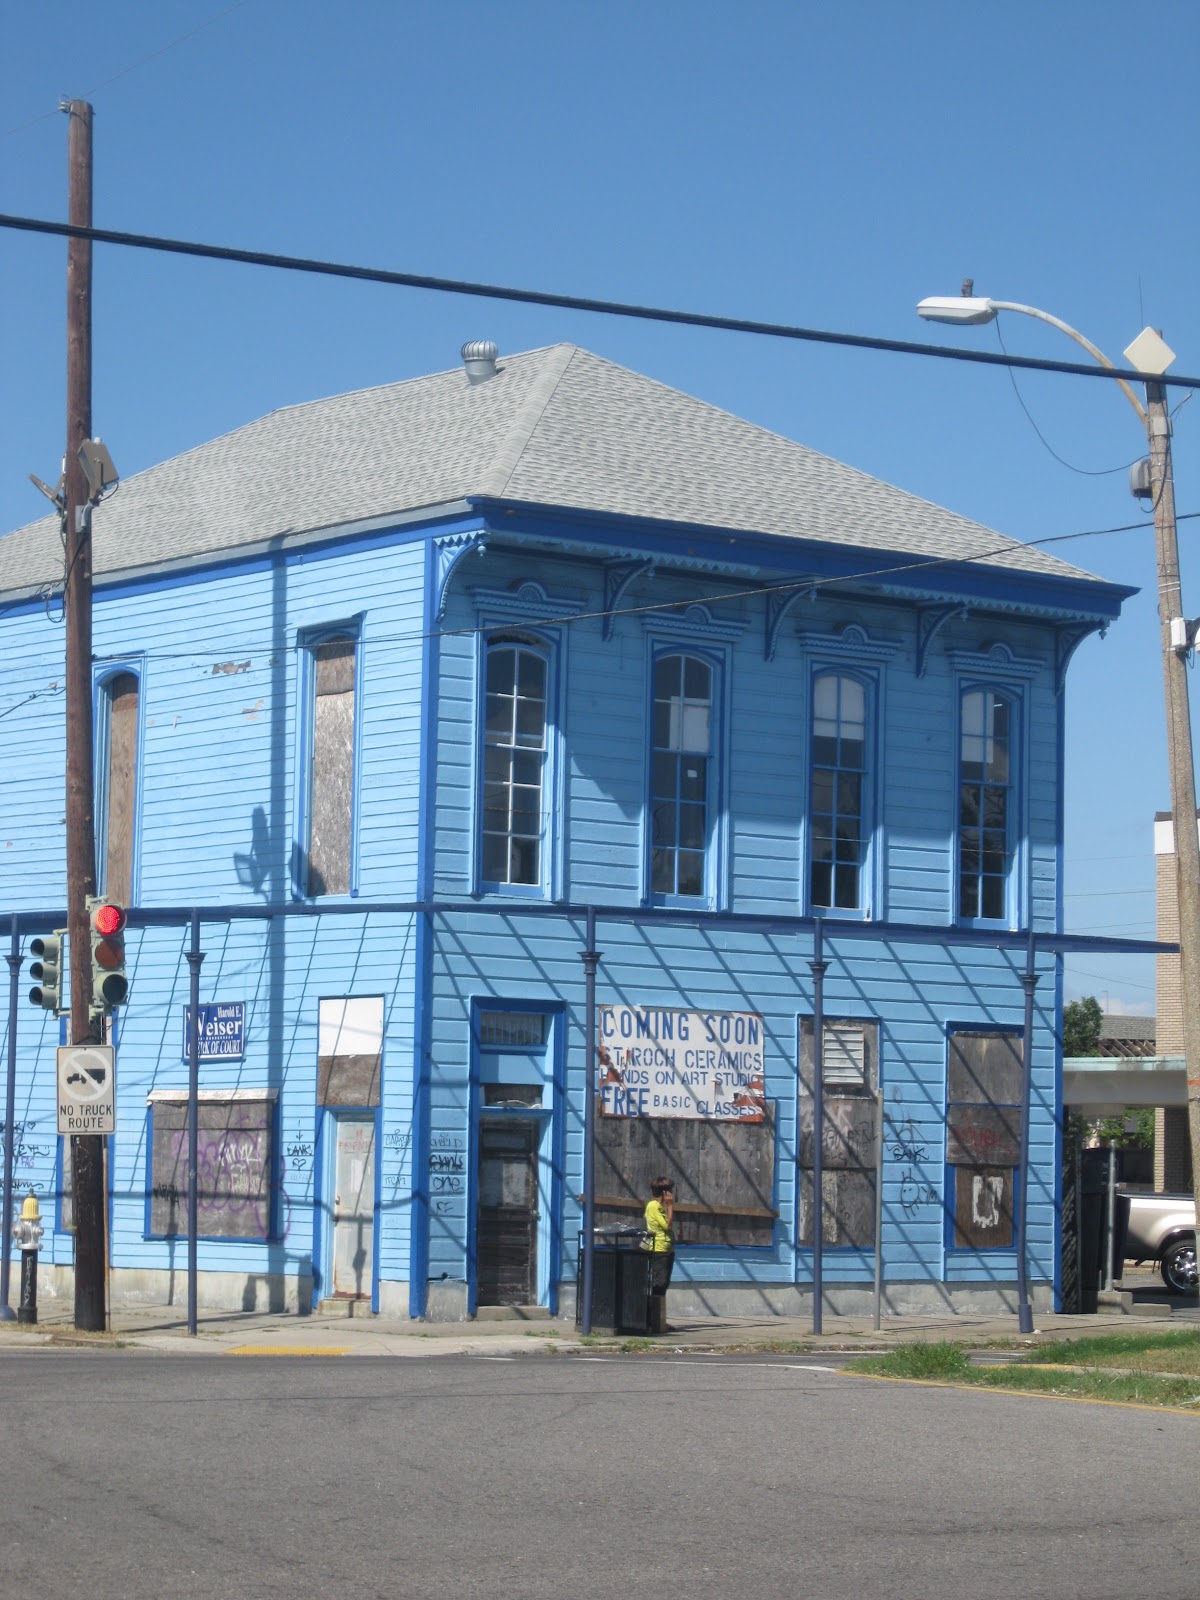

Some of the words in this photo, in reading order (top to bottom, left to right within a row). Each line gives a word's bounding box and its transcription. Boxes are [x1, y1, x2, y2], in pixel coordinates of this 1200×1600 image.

[217, 1006, 235, 1018] Harold
[602, 1010, 690, 1041] COMING
[705, 1015, 759, 1045] SOON
[210, 1041, 220, 1054] OF
[220, 1040, 240, 1053] COURT
[631, 1048, 676, 1067] ROCH
[685, 1050, 762, 1071] CERAMICS
[600, 1070, 649, 1085] HNDS
[655, 1072, 675, 1085] ON
[681, 1072, 708, 1086] ART
[601, 1086, 650, 1117] FREE
[654, 1095, 691, 1108] BASIC
[696, 1101, 756, 1116] CLASSES
[60, 1105, 74, 1116] NO
[79, 1104, 112, 1116] TRUCK
[68, 1117, 104, 1128] ROUTE
